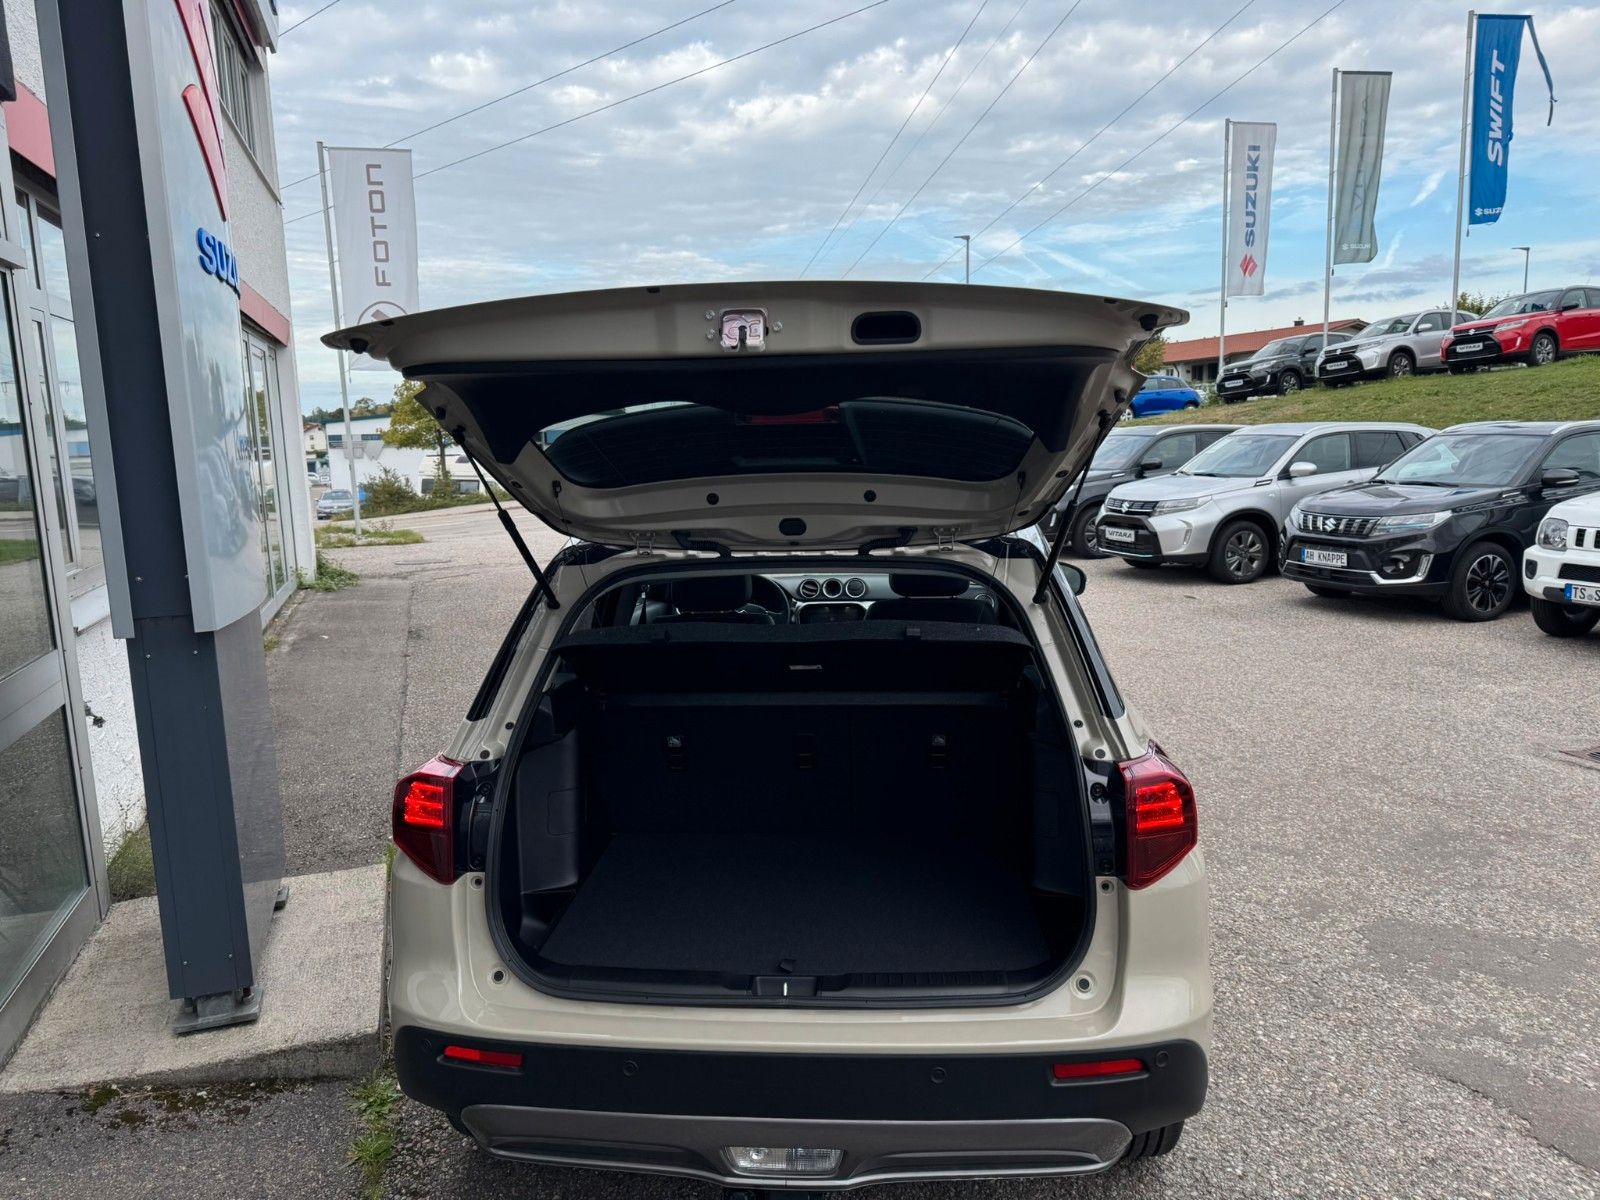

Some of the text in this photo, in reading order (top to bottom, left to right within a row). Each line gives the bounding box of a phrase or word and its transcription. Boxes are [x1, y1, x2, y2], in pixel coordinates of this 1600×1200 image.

[1488, 49, 1505, 167] SWIFT
[366, 164, 391, 286] FOTON
[1245, 145, 1261, 247] SUZUKI
[1108, 530, 1132, 538] VITARA
[1306, 551, 1345, 565] AH KNAPPE
[1572, 587, 1587, 600] TS
